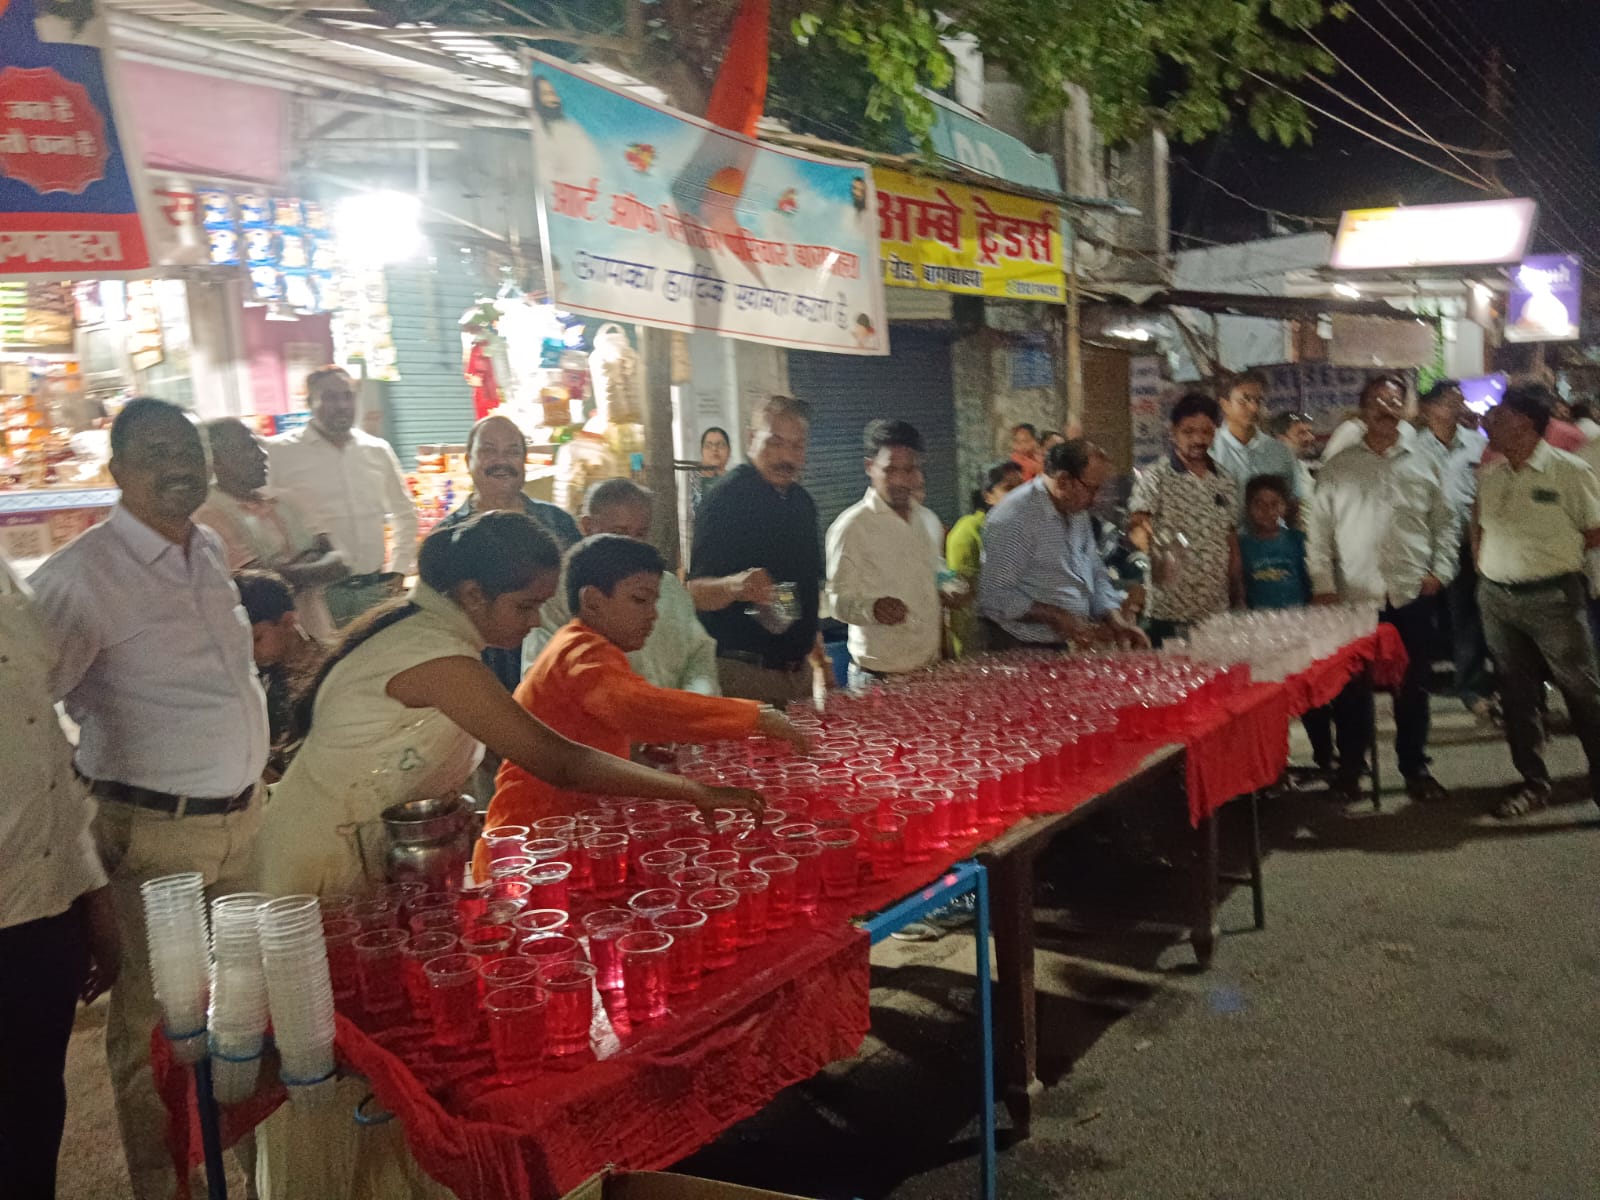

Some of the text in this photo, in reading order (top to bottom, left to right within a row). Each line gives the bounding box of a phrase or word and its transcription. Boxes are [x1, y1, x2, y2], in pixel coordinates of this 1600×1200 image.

[551, 177, 601, 222] आर्ट
[607, 192, 660, 234] ऑफ
[876, 186, 1054, 266] अम्बे ट्रेडर्स
[732, 283, 790, 317] स्वागत
[835, 290, 850, 331] है
